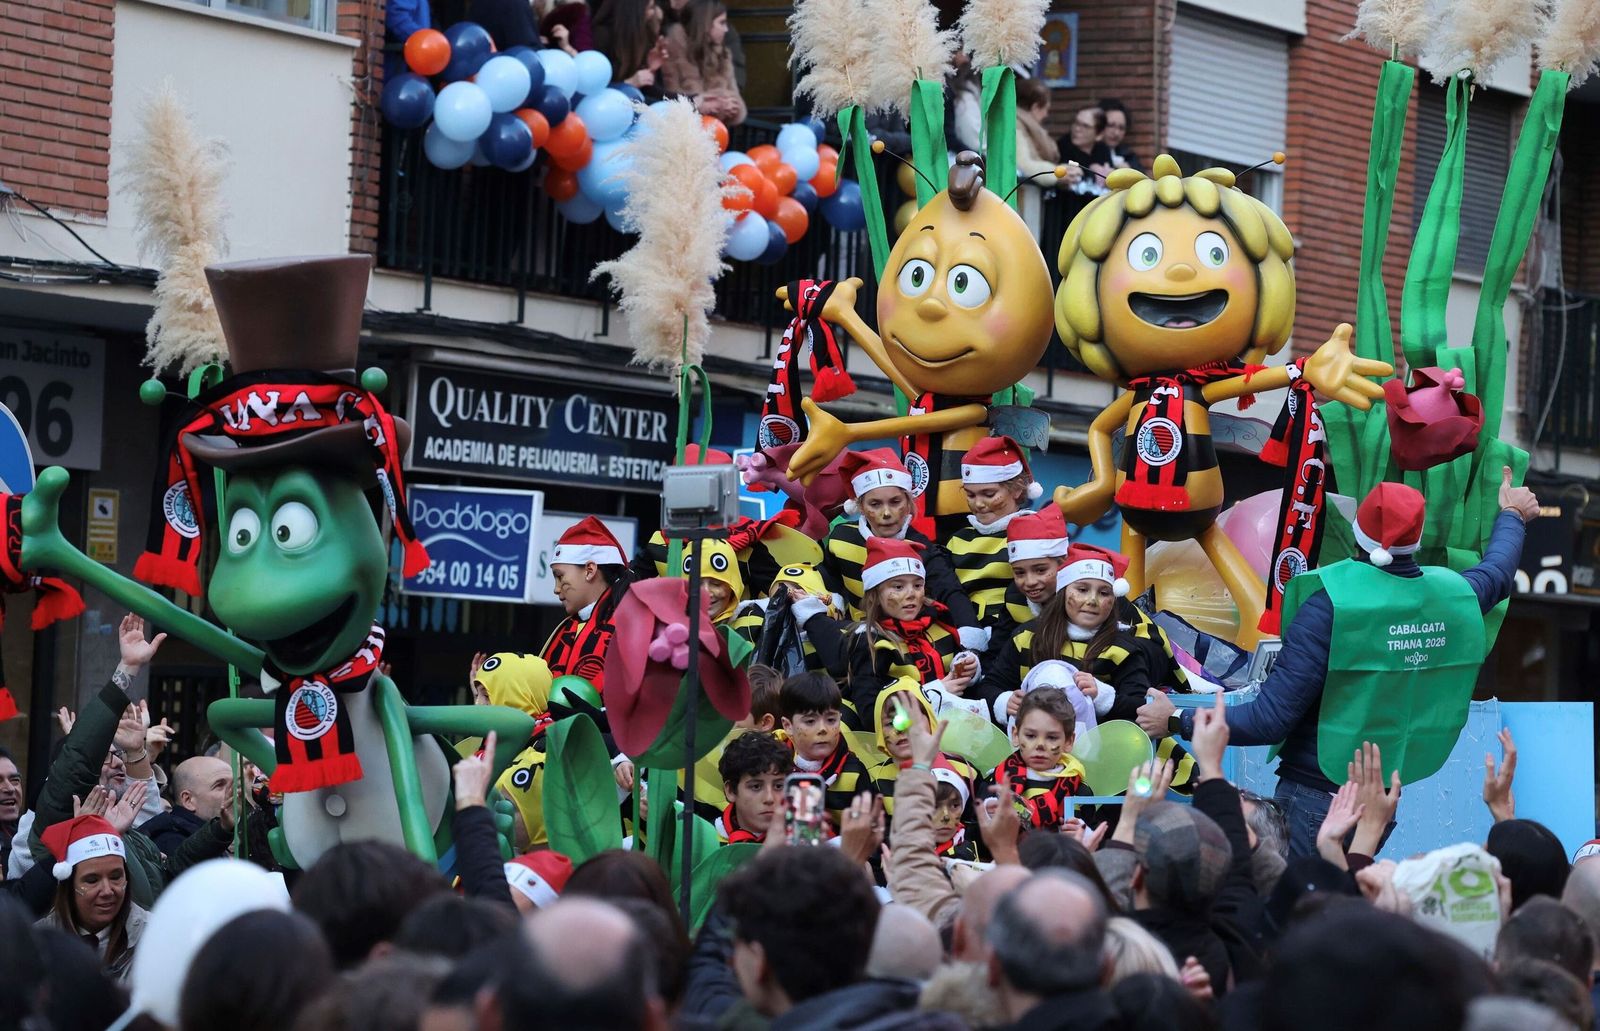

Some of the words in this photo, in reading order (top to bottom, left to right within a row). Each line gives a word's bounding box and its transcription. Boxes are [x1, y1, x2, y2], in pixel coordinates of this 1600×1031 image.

[22, 340, 91, 369] Jacinto
[429, 376, 554, 428] QUALITY
[564, 394, 668, 443] CENTER
[1138, 426, 1149, 455] TRIANA
[424, 436, 495, 465] ACADEMIA
[498, 444, 516, 466] DE
[518, 446, 599, 476] PELUQUERIA
[920, 461, 928, 490] TRIANA
[164, 487, 179, 522] TRIANA
[412, 499, 530, 540] Podólogo
[451, 561, 470, 587] 00
[475, 563, 494, 588] 14
[498, 565, 520, 591] 05
[1389, 622, 1446, 635] CABALGATA
[1387, 638, 1423, 651] TRIANA
[1425, 637, 1446, 648] 2026
[320, 686, 335, 722] TRIANA
